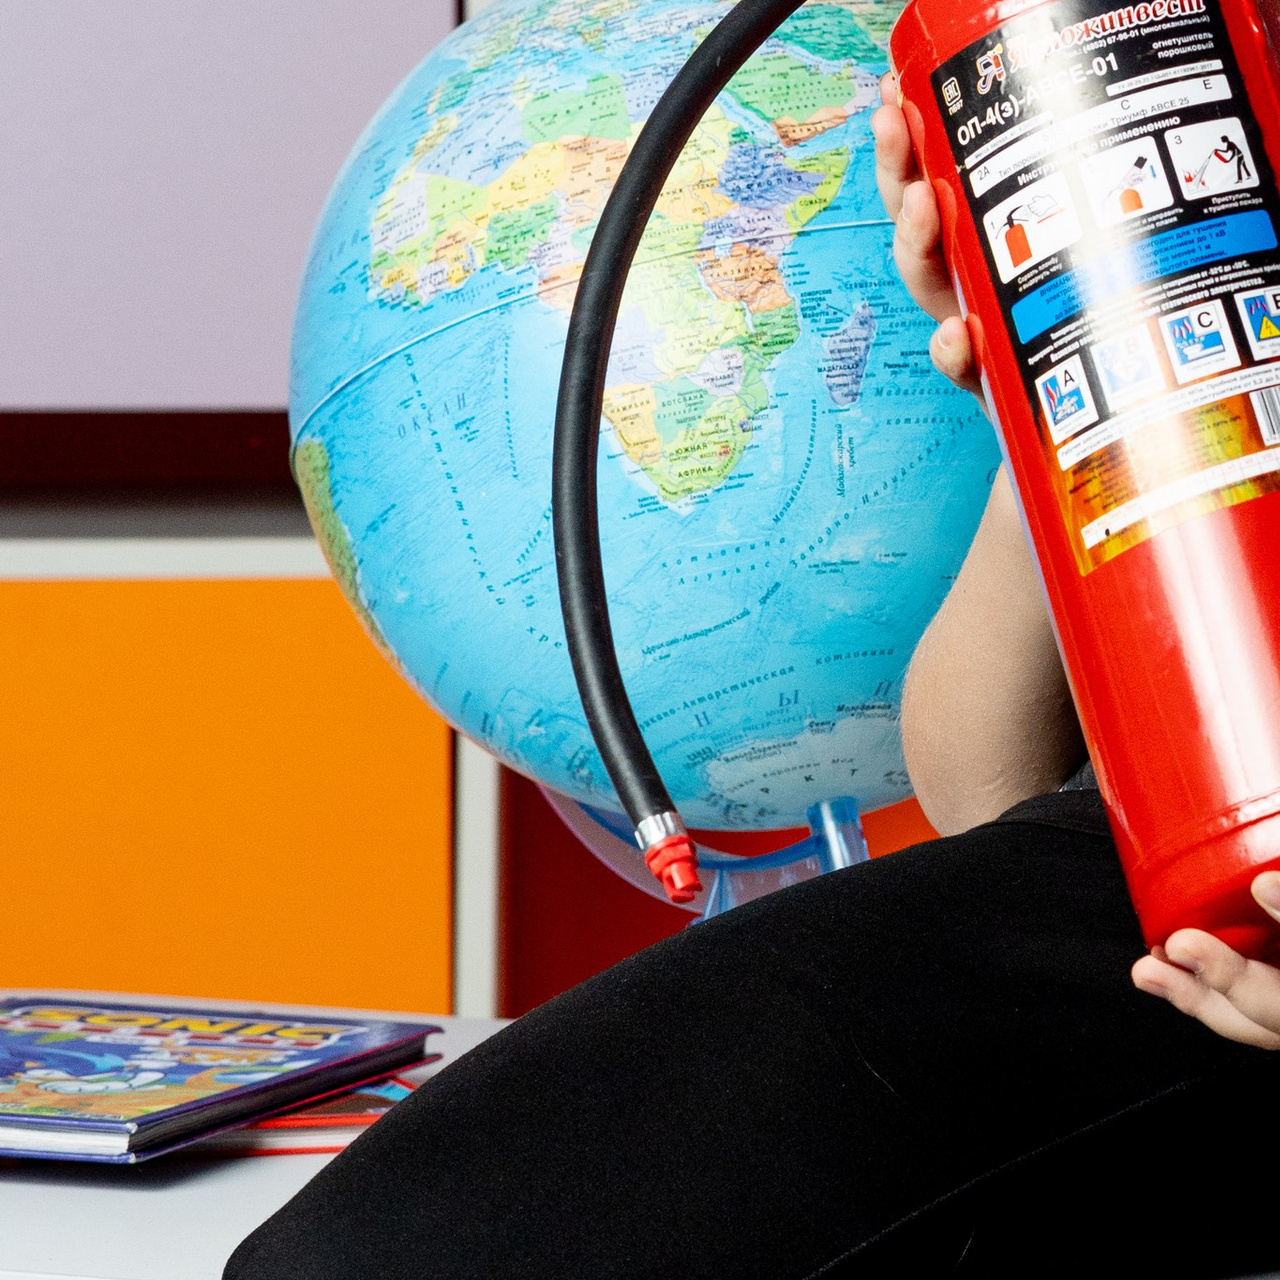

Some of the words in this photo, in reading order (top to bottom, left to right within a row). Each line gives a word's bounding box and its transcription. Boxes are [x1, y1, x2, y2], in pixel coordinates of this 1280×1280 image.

[1152, 31, 1214, 50] огнетушитель
[1157, 41, 1215, 60] порошковый
[1110, 108, 1149, 127] Триумф
[1151, 99, 1177, 114] АВСЕ
[1179, 96, 1191, 107] 25
[976, 165, 991, 181] 2А
[1120, 99, 1131, 111] С
[1202, 78, 1213, 91] Е
[1100, 115, 1181, 149] применению
[1174, 135, 1183, 146] 3
[799, 198, 828, 207] СОМАЛИ
[1175, 229, 1191, 240] для
[1192, 219, 1227, 235] тушения
[1196, 234, 1207, 244] до
[1209, 231, 1214, 239] 1
[1146, 260, 1188, 277] открытого
[1189, 249, 1228, 266] пламени.
[1170, 248, 1196, 262] менее
[800, 288, 832, 297] КОМОРСКИЕ
[801, 296, 826, 304] ОСТРОВА
[1197, 311, 1213, 328] С
[762, 338, 794, 349] МОЗАМБИК
[817, 363, 859, 373] МАДАГАСКАР
[703, 373, 735, 384] ЗИМБАБВЕ
[1064, 369, 1075, 388] А
[610, 399, 651, 414] НАМИБИЯ
[662, 393, 704, 408] БОТСВАНА
[675, 442, 708, 456] ЮЖНАЯ
[847, 436, 857, 468] хребет
[834, 423, 847, 498] Мадагаскарский
[678, 464, 714, 479] АФРИКА
[772, 456, 812, 525] Мозамбикская
[662, 536, 785, 569] котловина
[816, 648, 894, 666] котловина
[24, 1008, 343, 1041] SONIC
